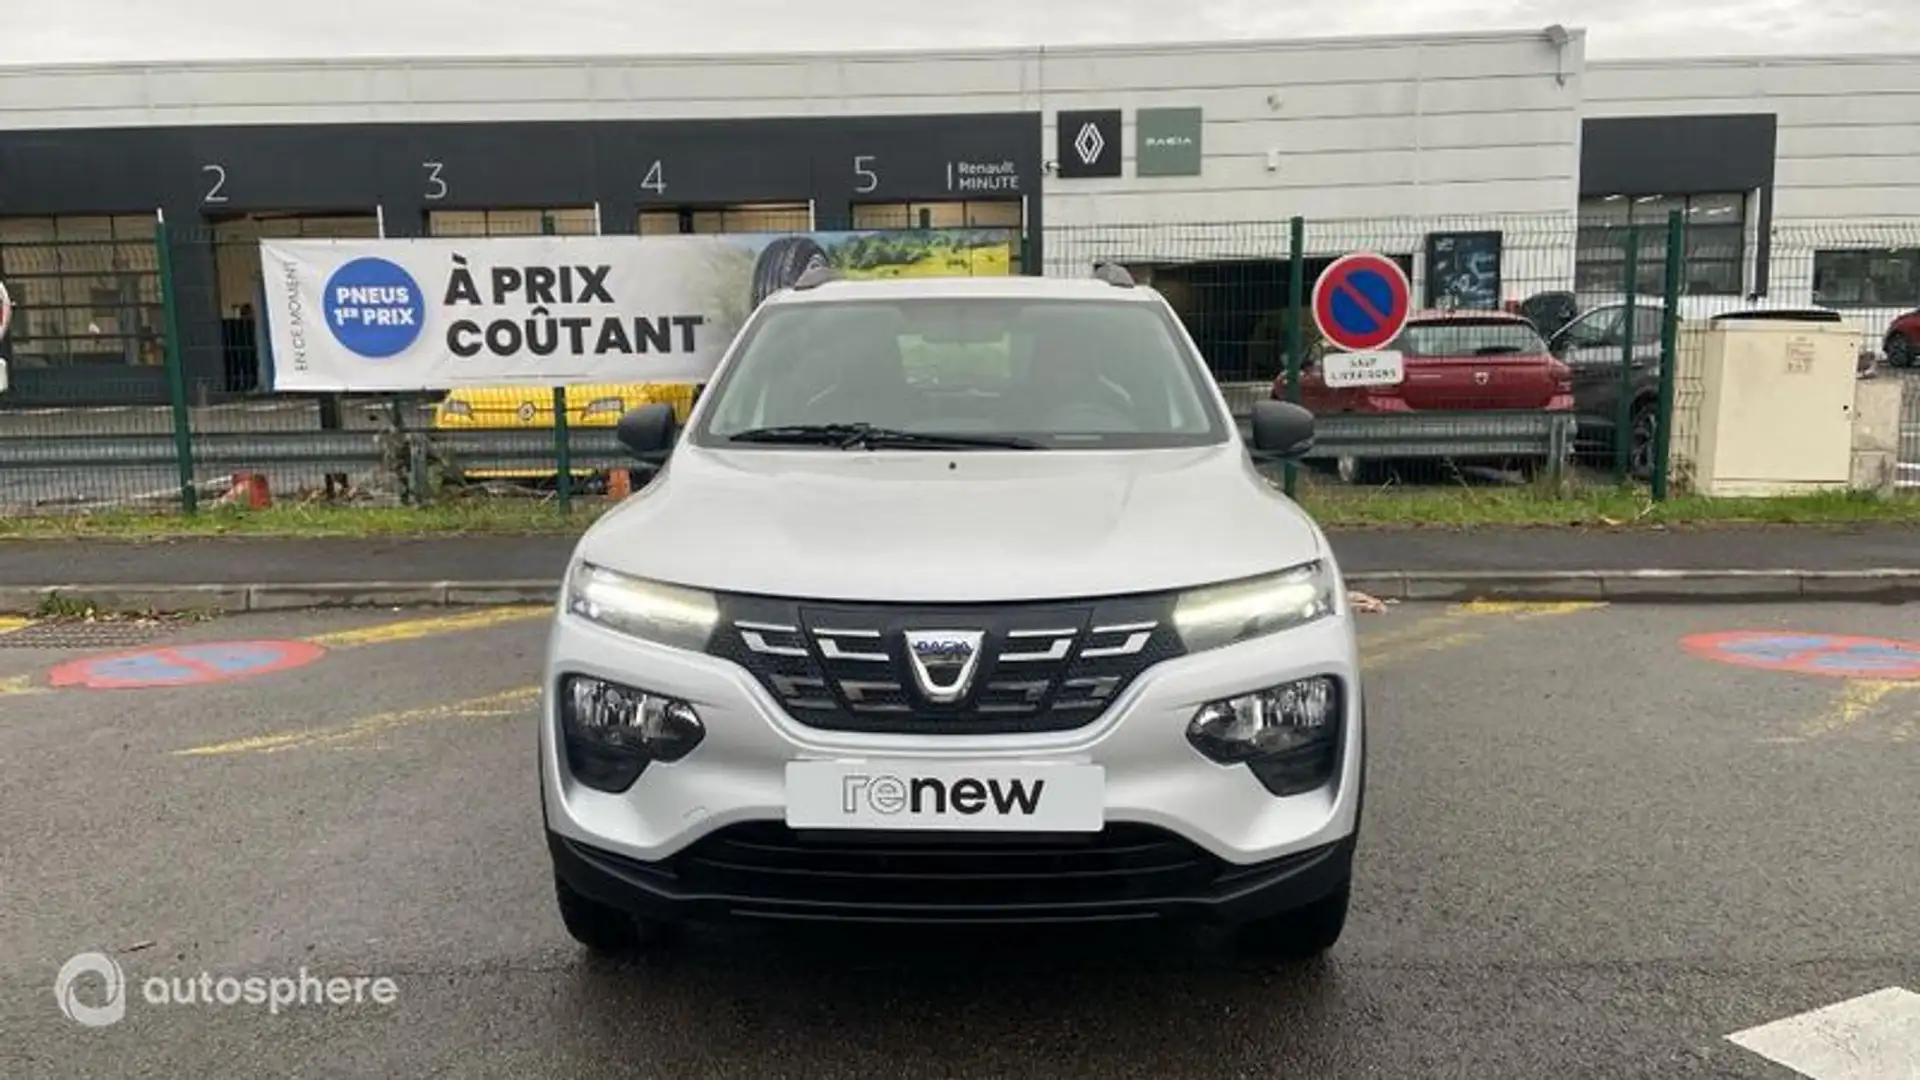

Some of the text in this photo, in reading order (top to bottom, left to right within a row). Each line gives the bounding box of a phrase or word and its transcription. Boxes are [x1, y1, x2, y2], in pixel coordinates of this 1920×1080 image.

[203, 165, 229, 202] 2
[423, 162, 448, 199] 3
[641, 160, 667, 194] 4
[854, 156, 878, 193] 5
[958, 161, 1015, 174] Renault
[960, 175, 1019, 191] MINUTE
[336, 286, 409, 305] PNEUS
[443, 253, 616, 306] À PRIX
[362, 308, 415, 326] PRIX
[446, 305, 704, 357] COÛTANT
[842, 774, 1044, 815] renew
